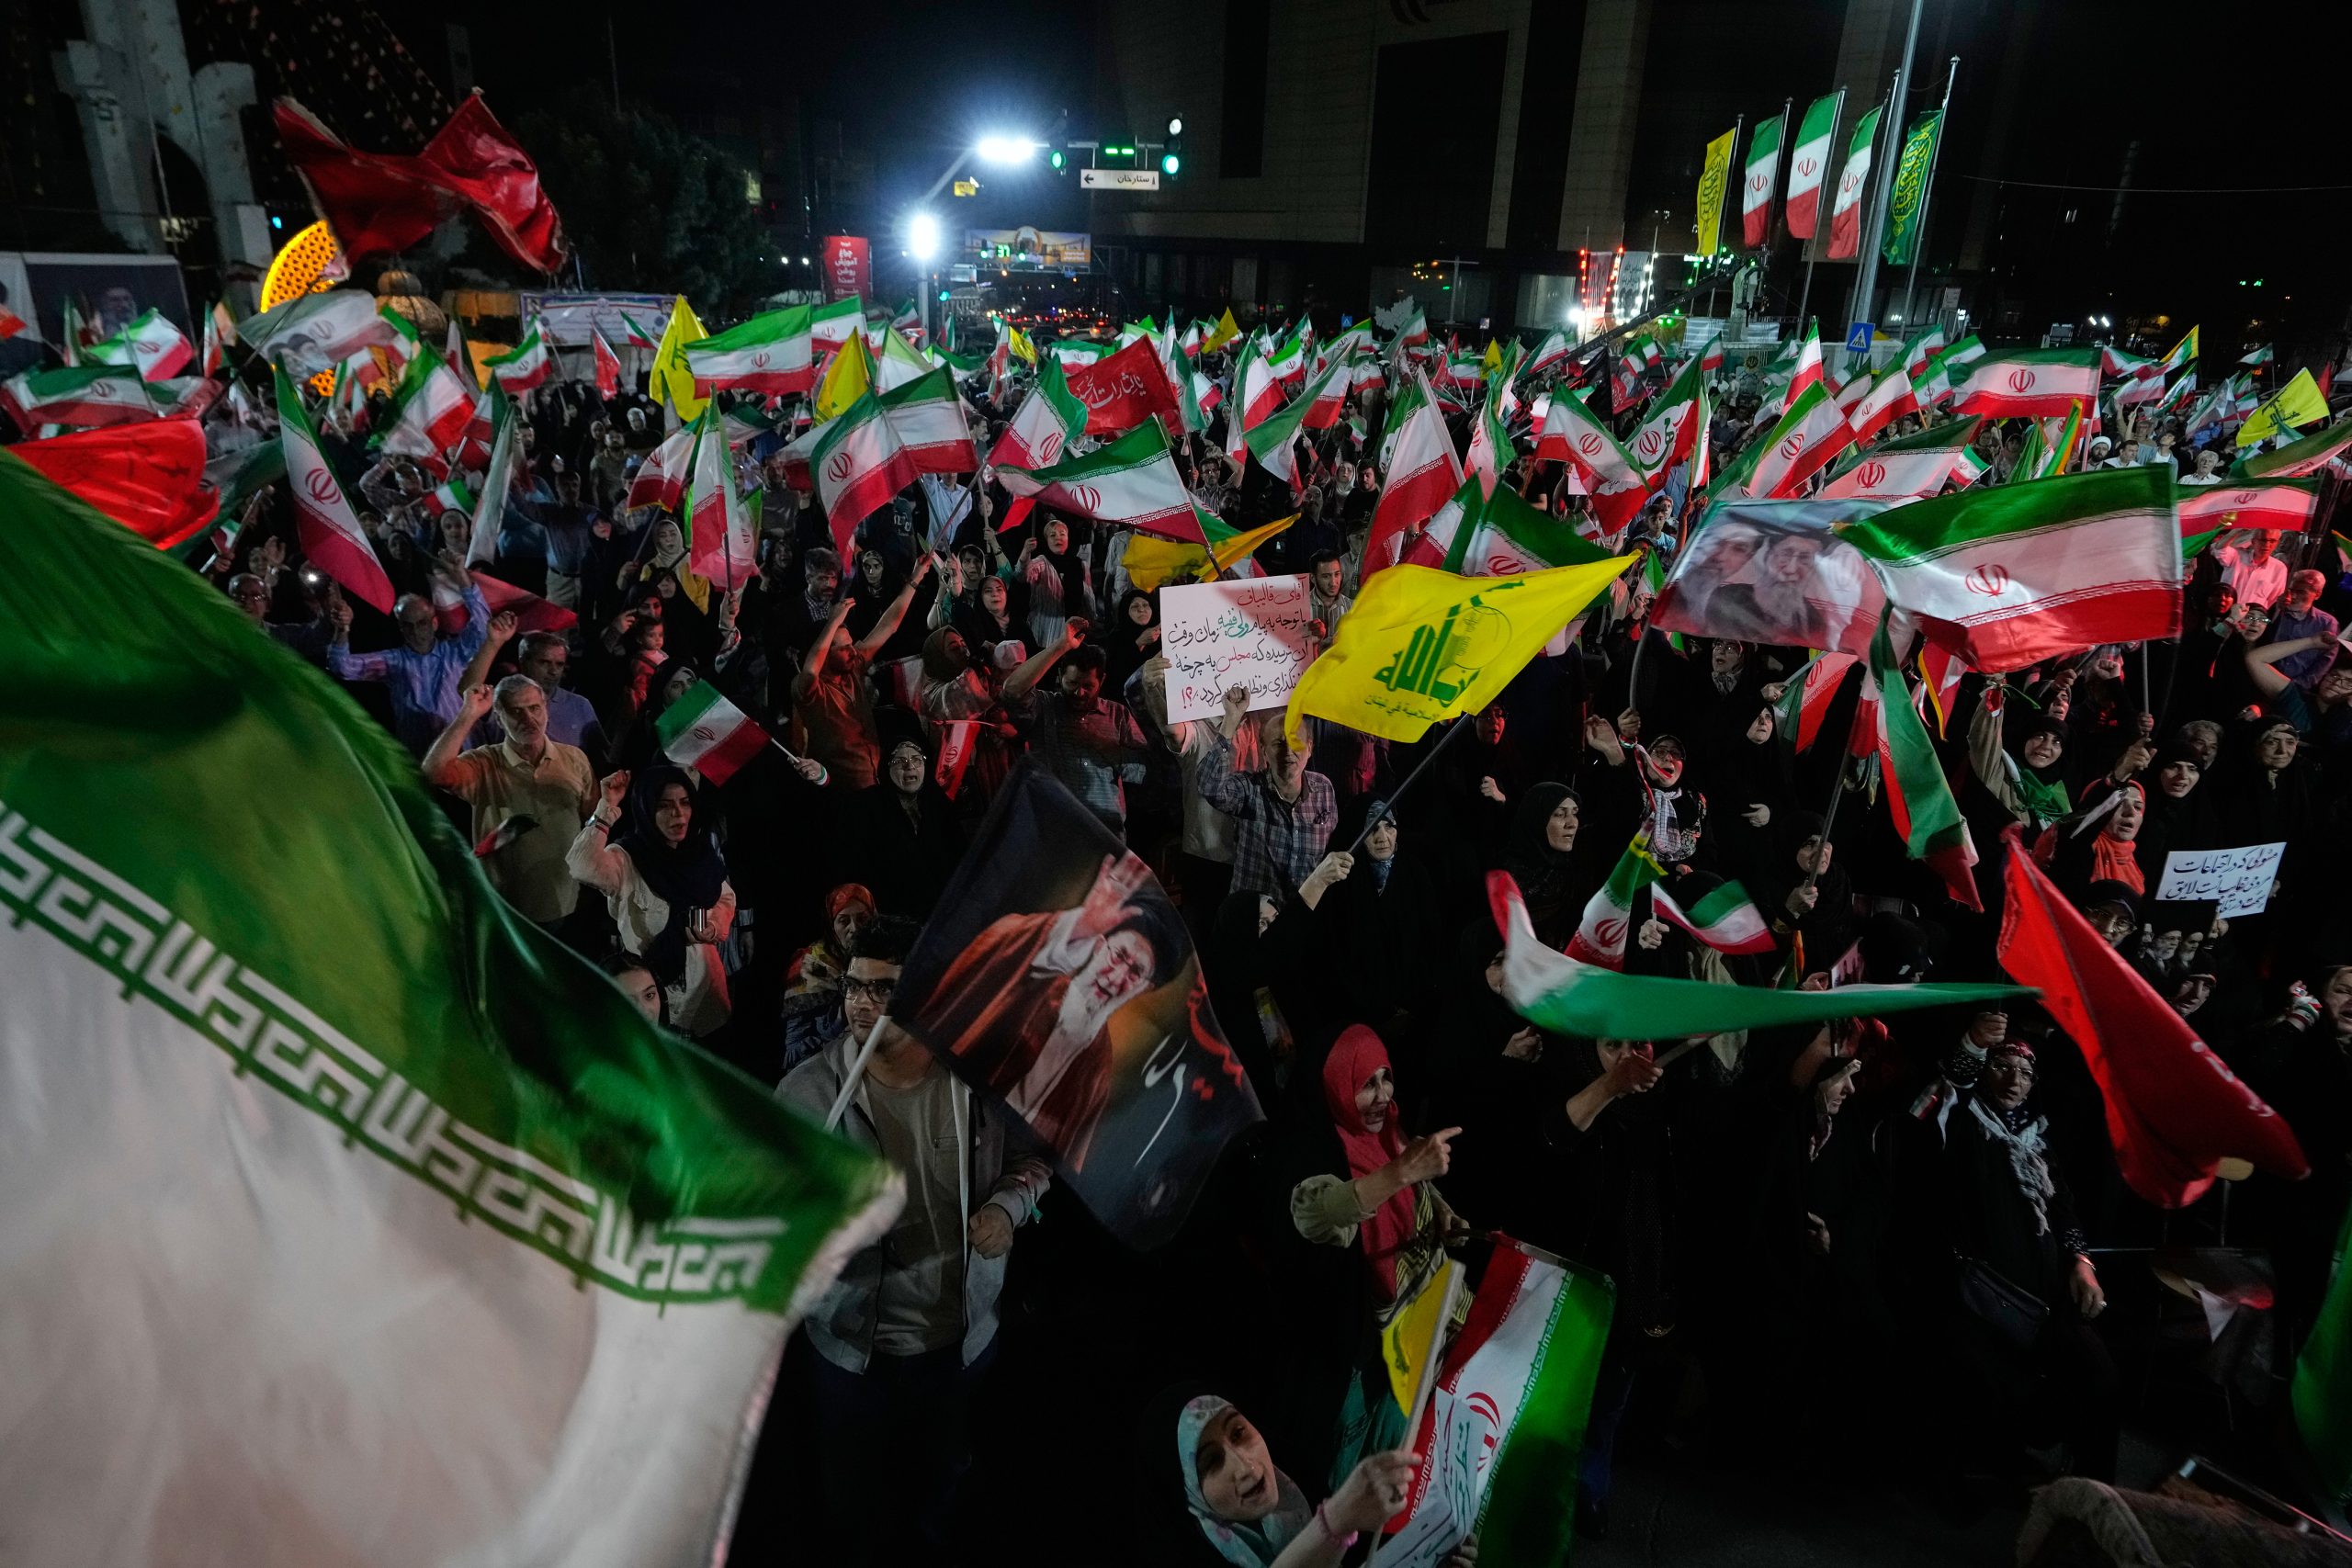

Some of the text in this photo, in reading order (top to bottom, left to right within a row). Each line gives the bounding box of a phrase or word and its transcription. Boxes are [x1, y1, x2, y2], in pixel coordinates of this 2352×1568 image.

[1117, 175, 1149, 185] ستارخان
[1238, 576, 1306, 608] آقای قالیباف
[1194, 617, 1220, 643] زمان
[1227, 610, 1250, 638] ولی
[1250, 614, 1267, 636] پیام
[1266, 616, 1275, 631] به
[1275, 611, 1300, 630] توجه
[1216, 647, 1251, 672] مجلس
[1251, 638, 1265, 660] که
[1266, 645, 1292, 664] نرسیده
[1292, 637, 1308, 661] آن
[1205, 655, 1216, 671] به
